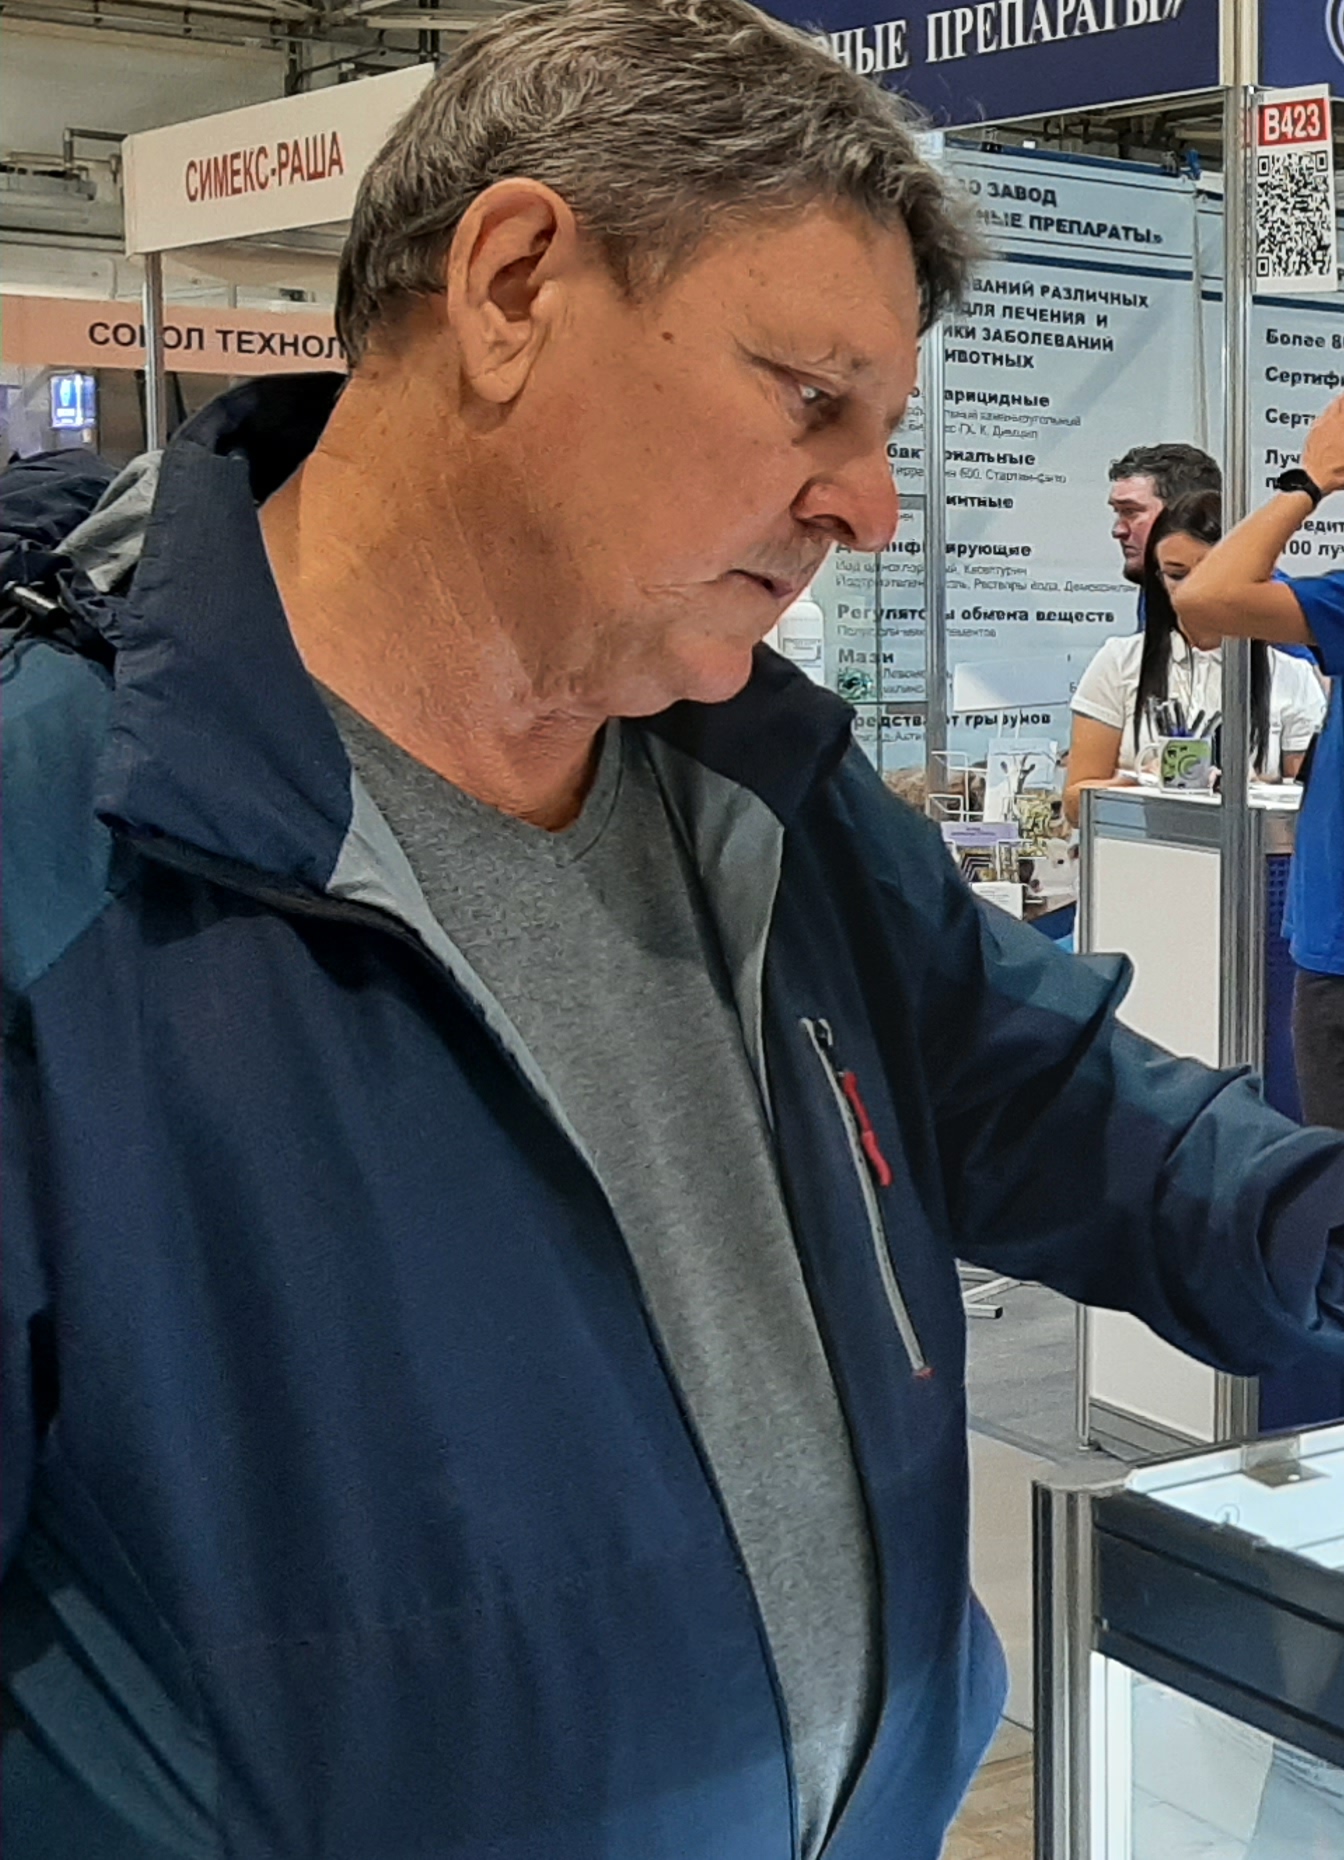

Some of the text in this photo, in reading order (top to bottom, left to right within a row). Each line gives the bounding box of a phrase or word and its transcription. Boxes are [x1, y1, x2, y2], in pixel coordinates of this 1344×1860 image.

[820, 20, 909, 76] НЫЕ
[1263, 100, 1322, 142] B423
[185, 131, 343, 202] СИМЕКС-РАША
[987, 182, 1058, 208] ЗАВОД
[967, 278, 1149, 308] ВАНИЙ РАЗЛИЧНЫХ
[88, 322, 204, 351] СООЛ
[982, 327, 1114, 351] ЗАБОЛЕВАНИЙ
[1266, 328, 1326, 348] Более
[961, 606, 1029, 622] обмена
[1035, 610, 1115, 625] веществ
